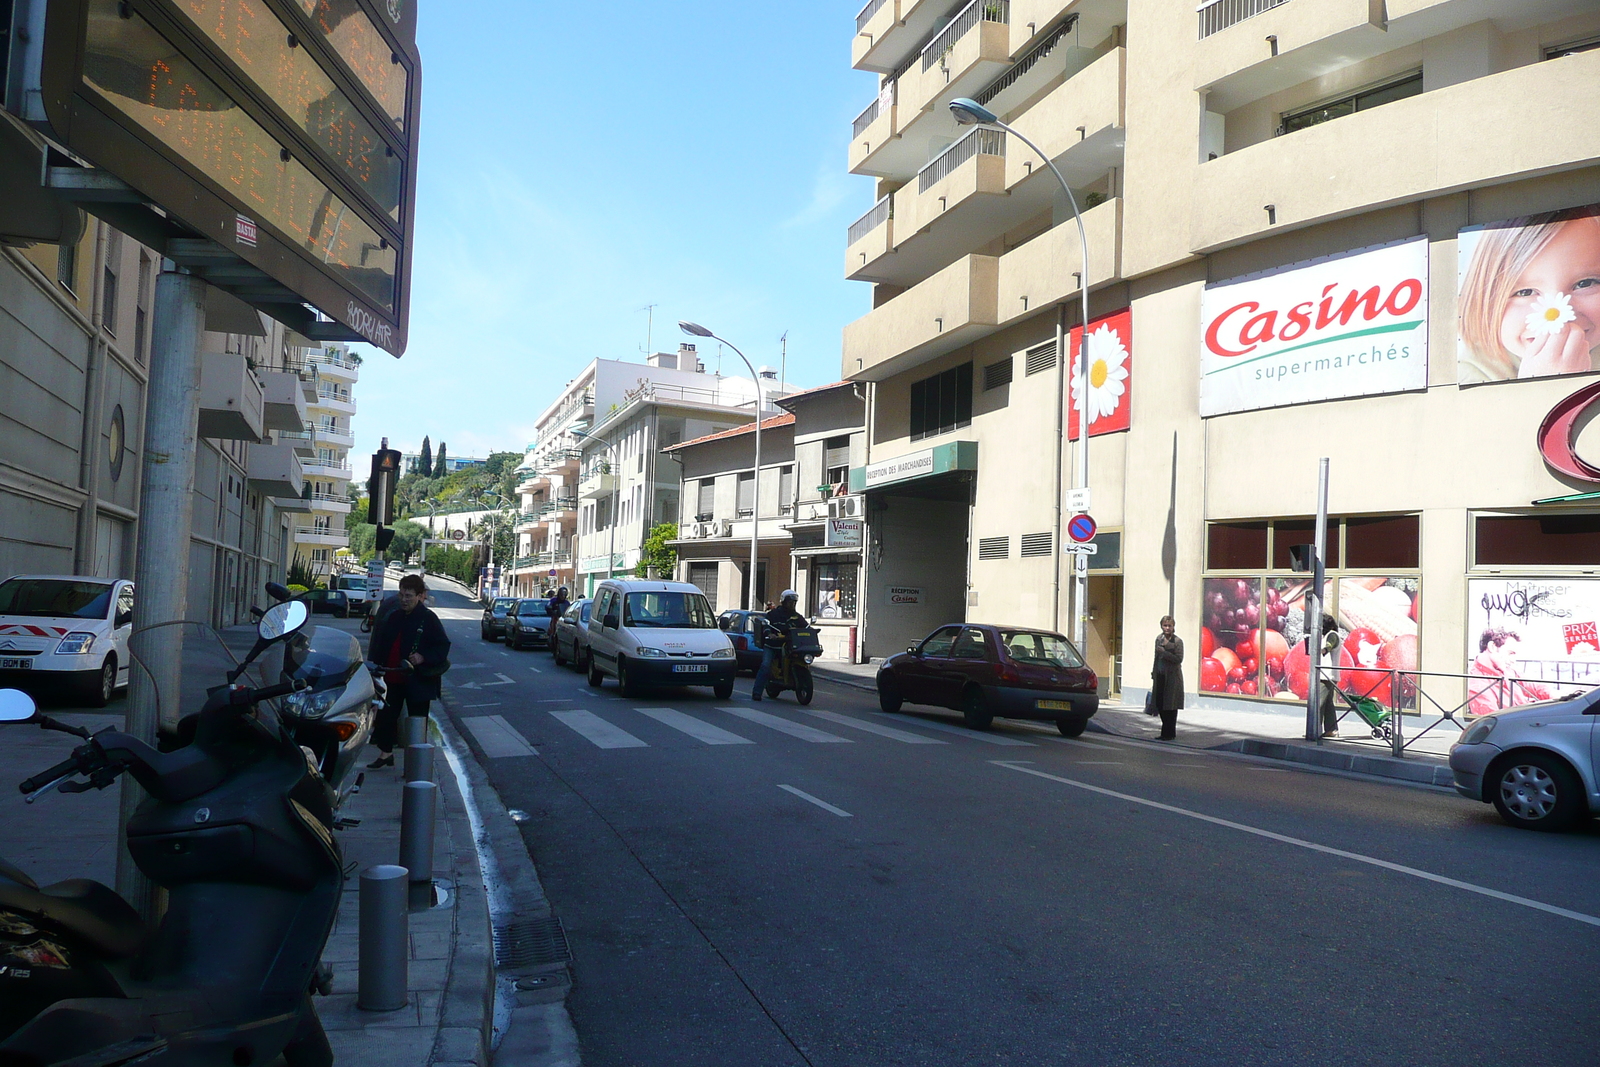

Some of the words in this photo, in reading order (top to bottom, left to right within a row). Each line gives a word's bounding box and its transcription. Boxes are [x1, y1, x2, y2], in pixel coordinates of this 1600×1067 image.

[1205, 278, 1423, 357] Casino
[1255, 343, 1411, 381] supermarchés
[888, 465, 897, 475] DES
[897, 456, 932, 473] MARCHANDISES
[832, 520, 859, 532] Valenti
[891, 594, 918, 603] Casino
[1564, 622, 1597, 637] PRIX
[10, 968, 31, 978] 125
